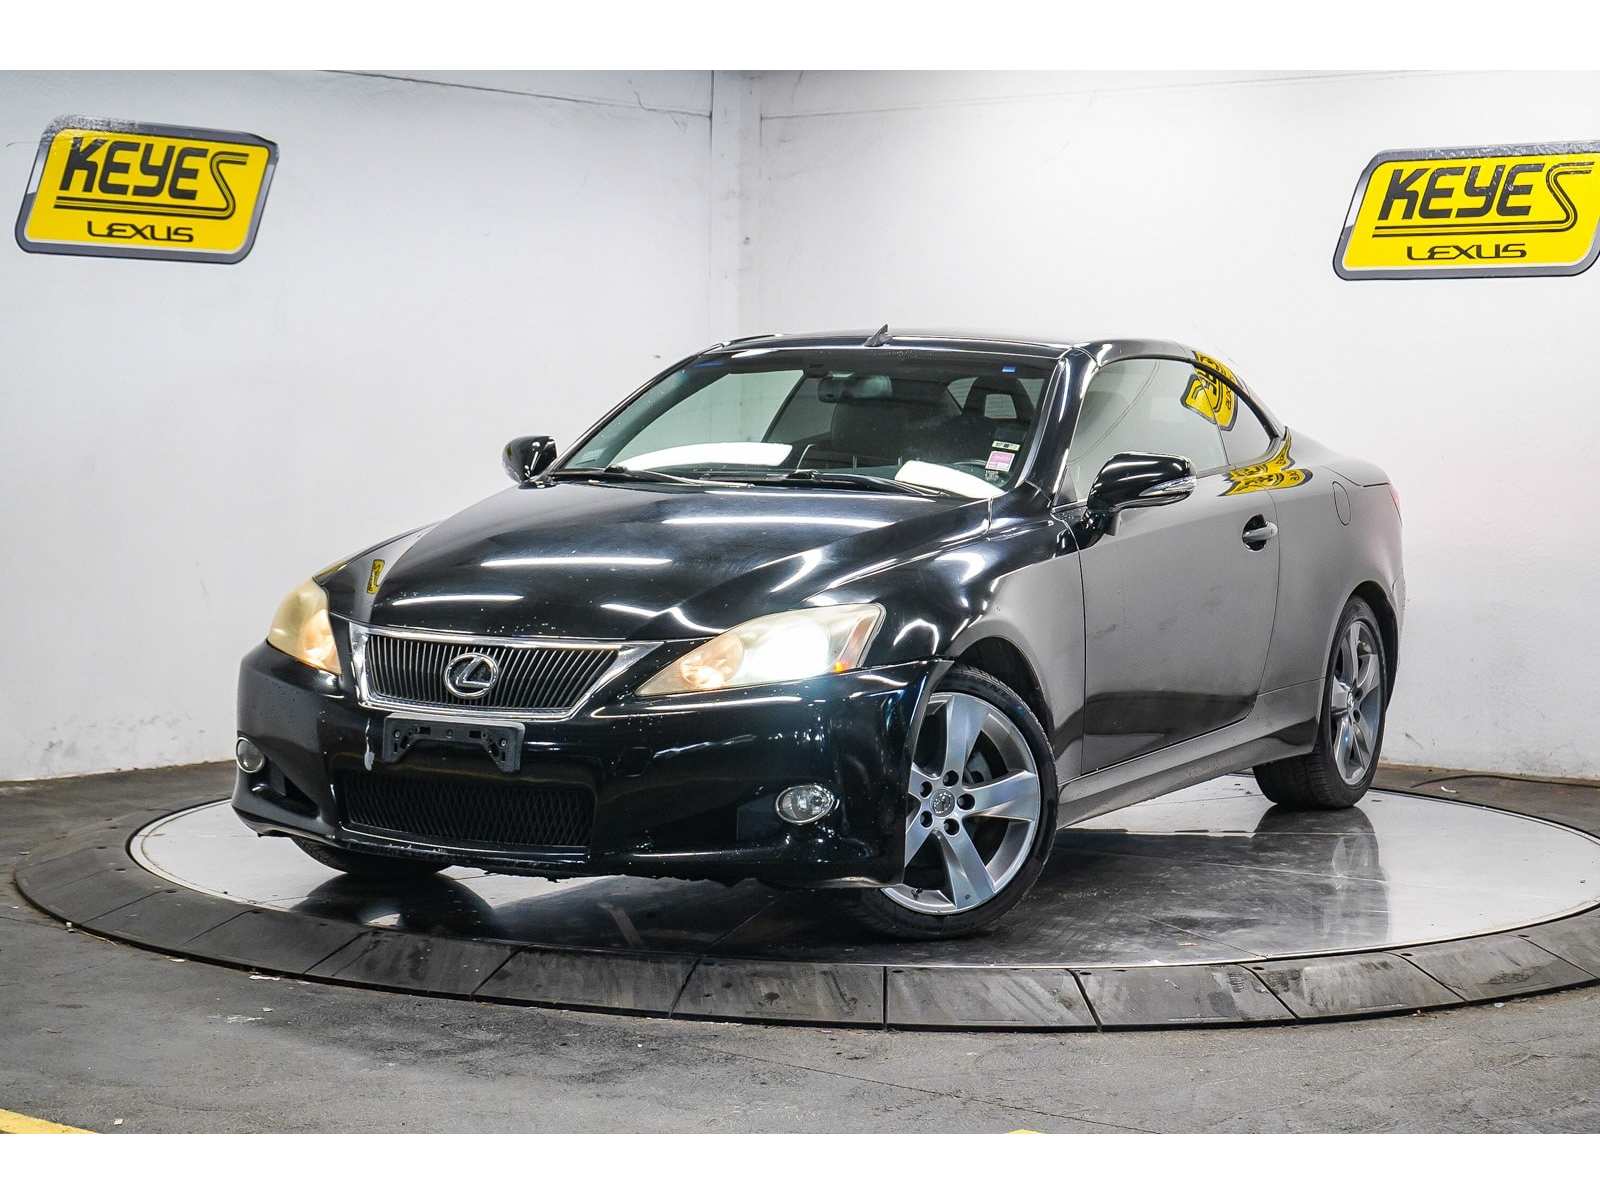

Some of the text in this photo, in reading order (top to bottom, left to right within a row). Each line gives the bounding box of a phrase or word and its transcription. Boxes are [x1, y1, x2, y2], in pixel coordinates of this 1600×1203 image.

[55, 136, 250, 220] KEYES
[1372, 161, 1595, 238] KEYES
[86, 220, 194, 243] LEXUS
[1406, 243, 1528, 261] LEXUS
